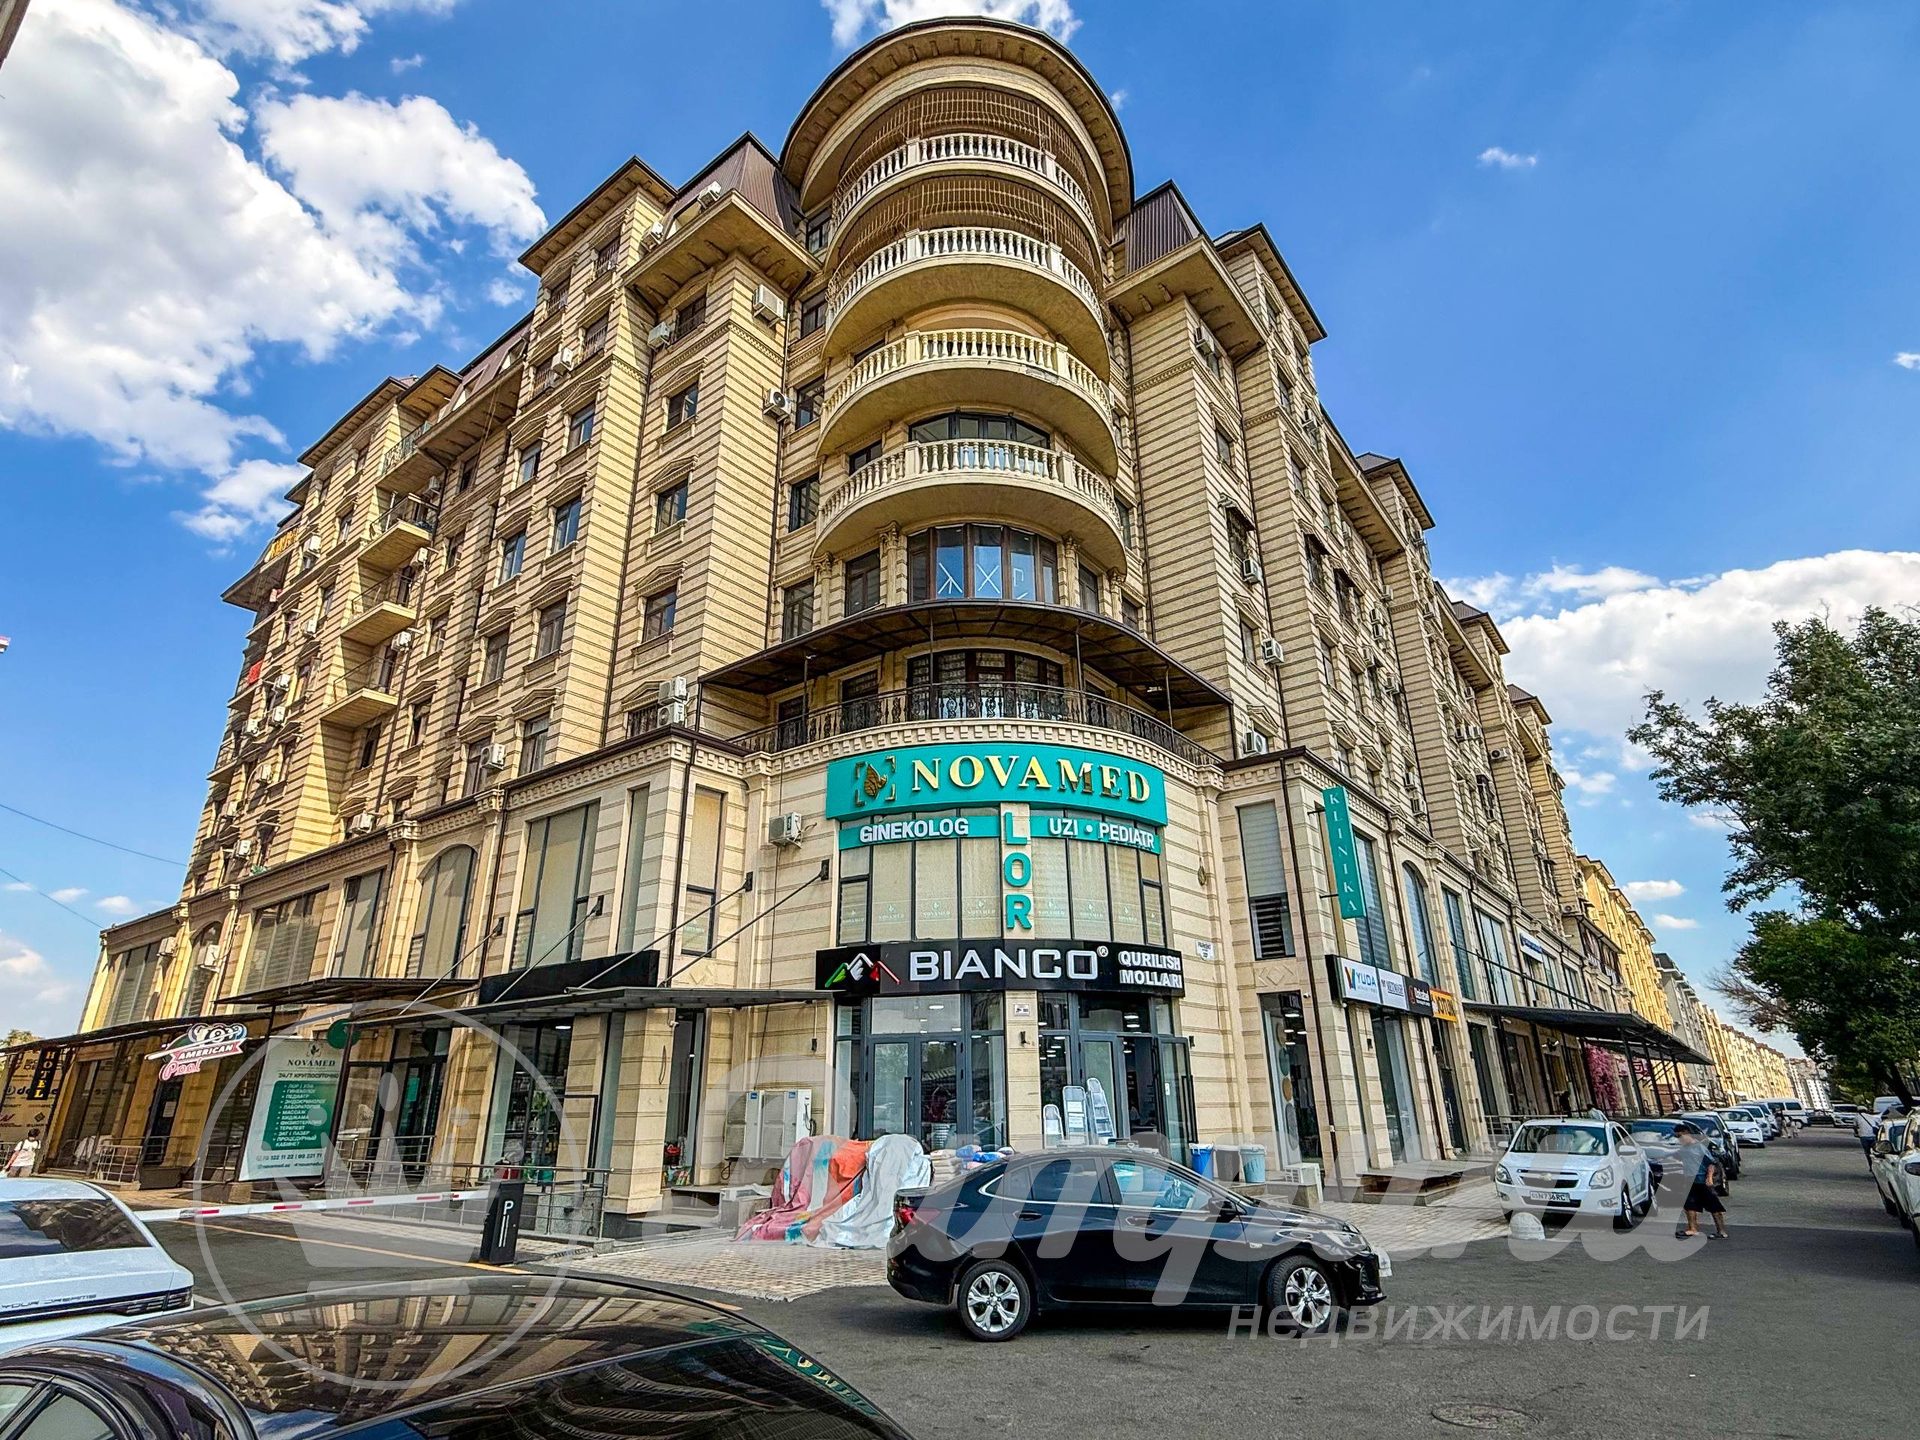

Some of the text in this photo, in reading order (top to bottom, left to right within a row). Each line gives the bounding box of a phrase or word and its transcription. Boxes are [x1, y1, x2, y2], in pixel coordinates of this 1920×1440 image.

[911, 755, 1151, 802] NOVAMED
[859, 817, 970, 844] GINEKOLOG
[1049, 817, 1155, 849] UZI PEDIATR
[1328, 793, 1358, 911] KLINIKA
[1002, 810, 1033, 930] LOR
[1118, 951, 1182, 971] QURILISH
[1118, 969, 1183, 989] MOLLARI
[1356, 972, 1377, 987] YUDA
[178, 1044, 235, 1060] AMERICAN
[287, 1059, 336, 1067] NOVAMED
[34, 1051, 56, 1099] HOTEL
[160, 1058, 202, 1080] Pool
[503, 1200, 515, 1215] P
